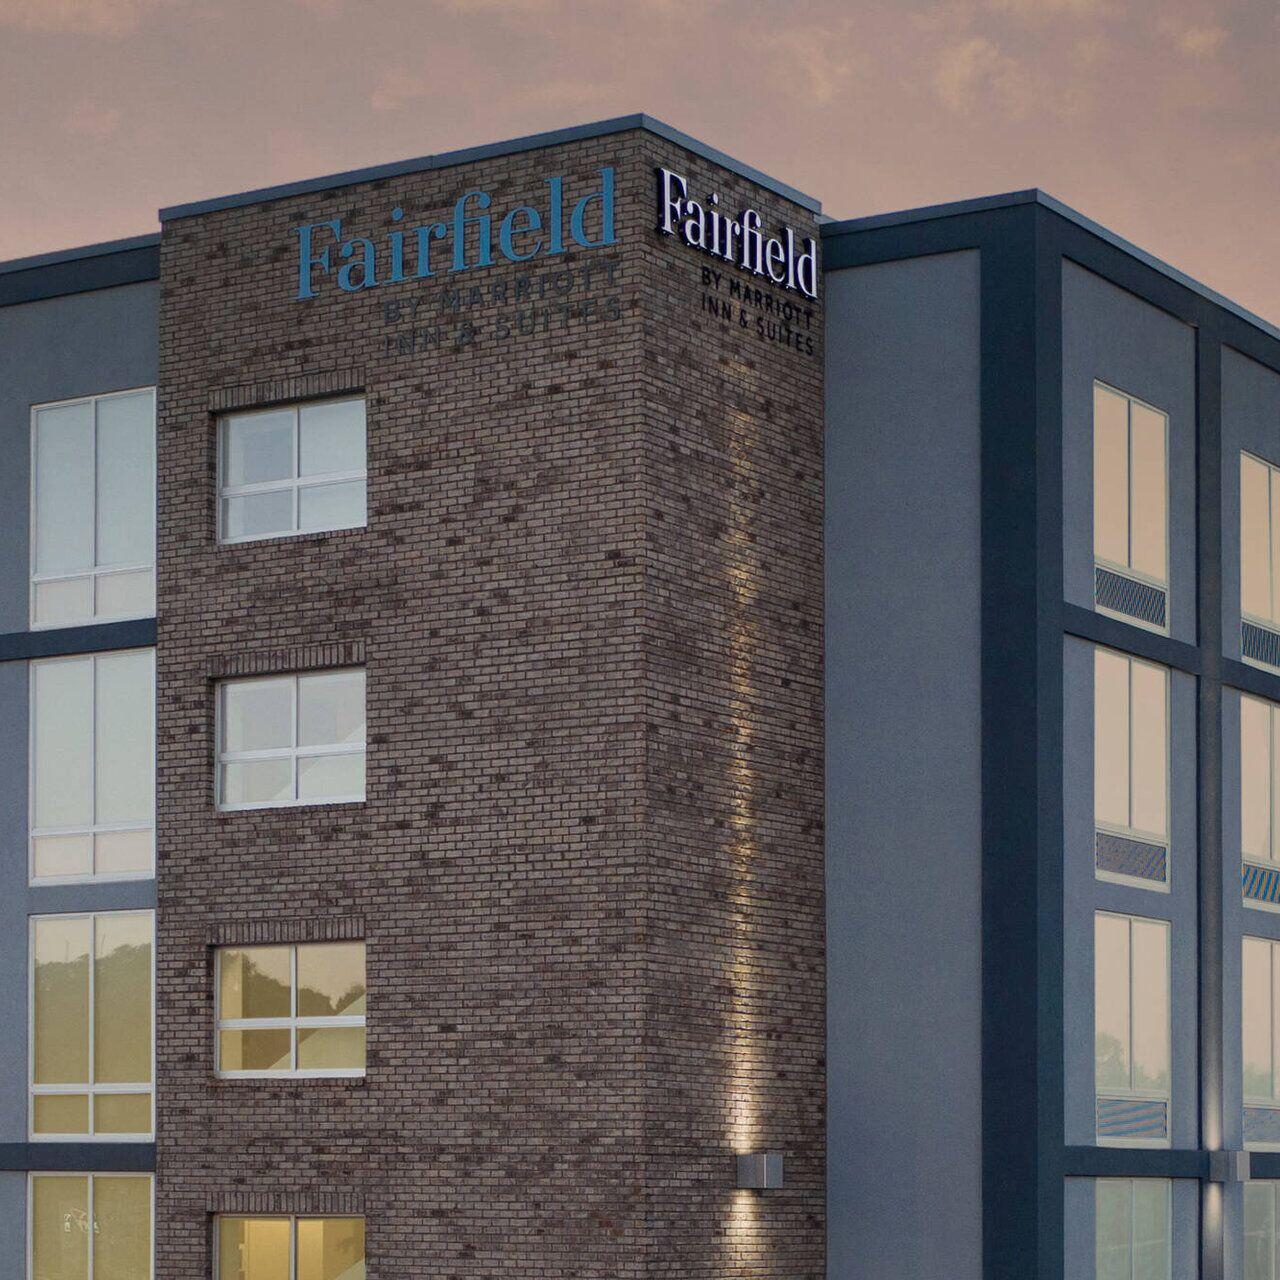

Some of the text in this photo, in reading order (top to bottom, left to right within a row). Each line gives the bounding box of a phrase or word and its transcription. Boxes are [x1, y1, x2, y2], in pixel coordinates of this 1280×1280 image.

[294, 167, 621, 301] Fairfield
[658, 167, 818, 300] Fairfield
[383, 260, 621, 324] BY MARRIOTT
[702, 266, 813, 330] BY MARRIOTT
[384, 295, 621, 358] INN & SUITES
[702, 294, 814, 356] INN & SUITES
